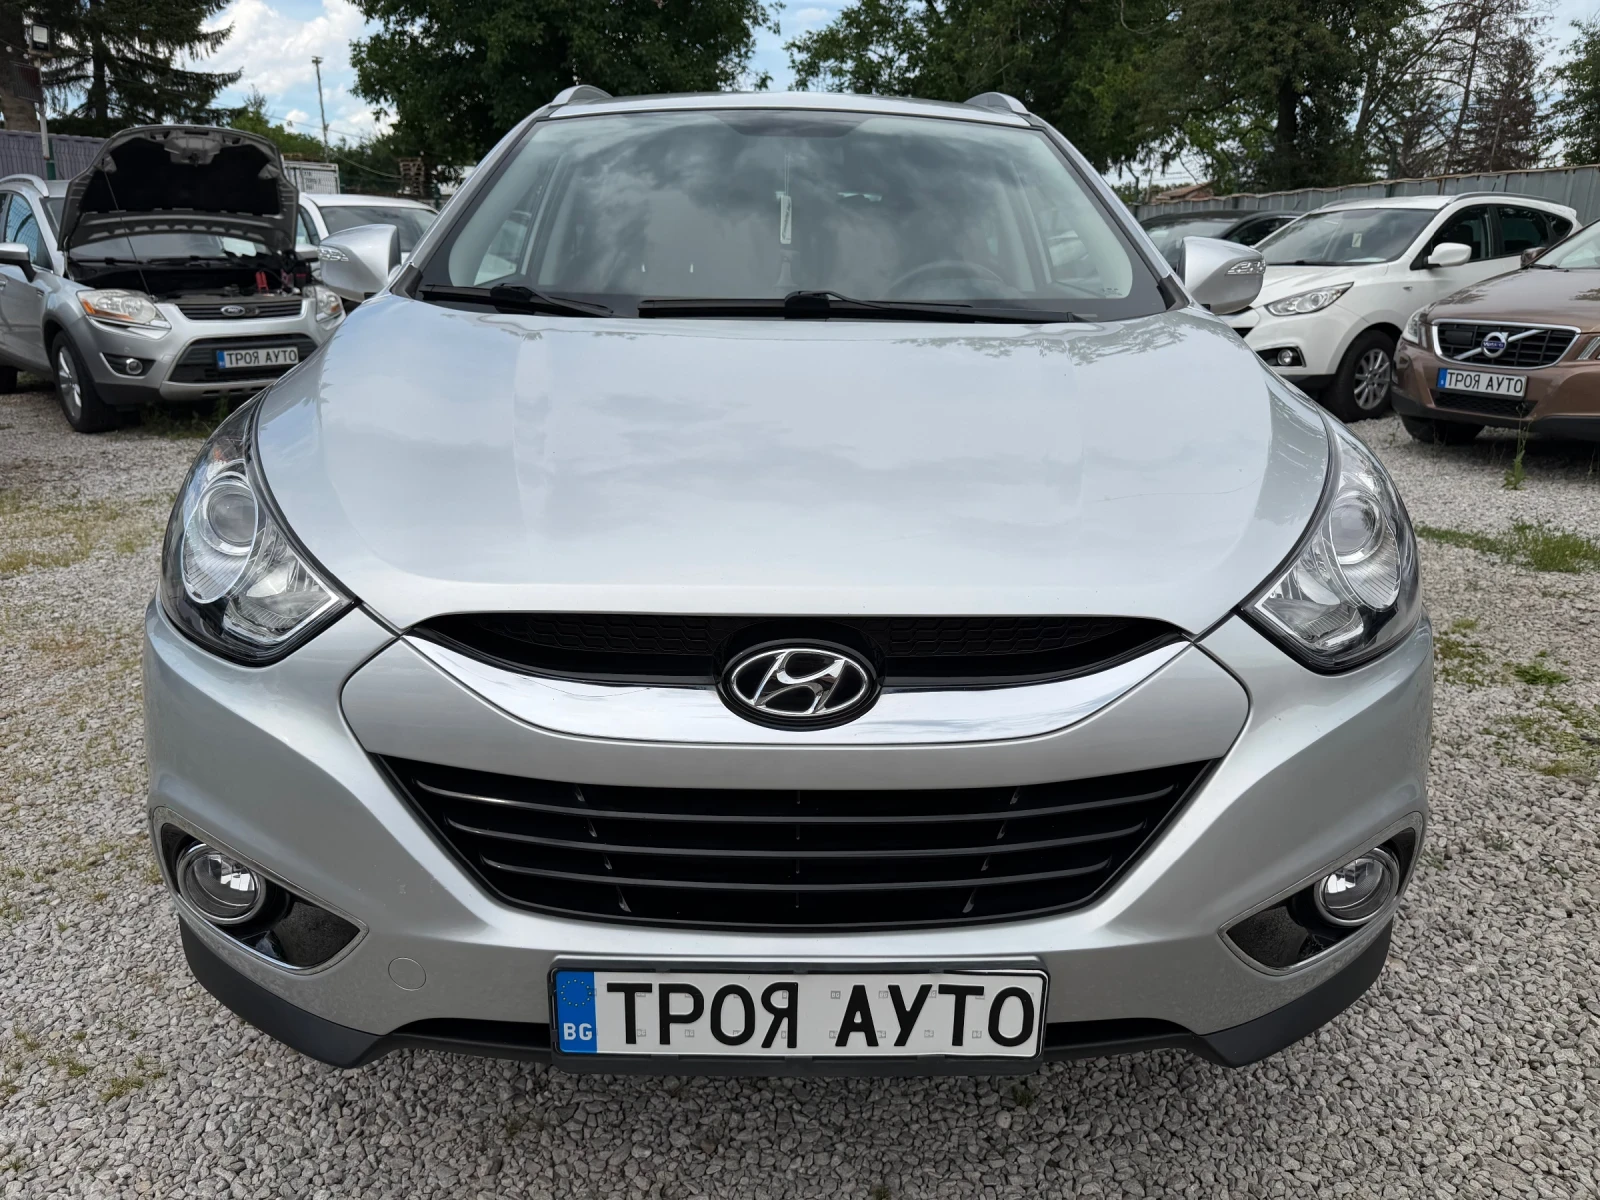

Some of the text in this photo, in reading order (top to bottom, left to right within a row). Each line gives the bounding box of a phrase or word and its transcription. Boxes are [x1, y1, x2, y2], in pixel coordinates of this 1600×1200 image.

[226, 351, 260, 366] ТРОЯ
[265, 349, 298, 363] АУТО
[1447, 372, 1524, 394] ТРОЯ АУТО
[607, 981, 1035, 1049] ТРОЯ АУТО
[563, 1022, 593, 1041] BG
